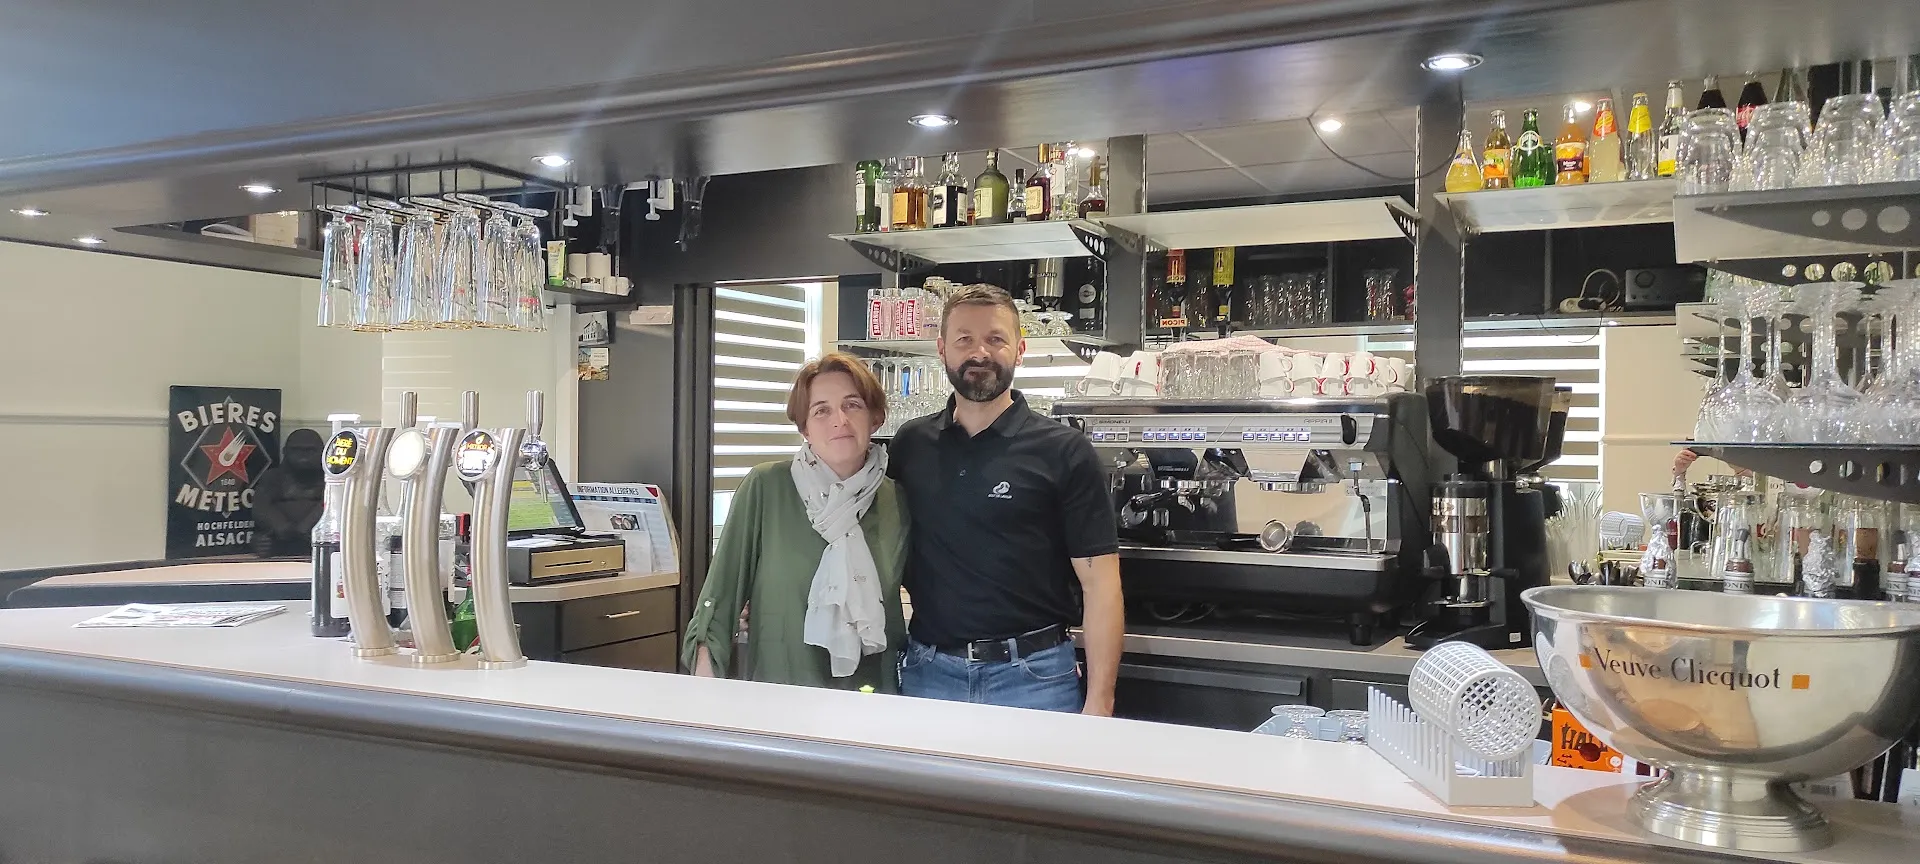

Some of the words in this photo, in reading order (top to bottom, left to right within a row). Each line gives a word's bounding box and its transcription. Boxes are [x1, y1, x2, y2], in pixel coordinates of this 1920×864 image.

[177, 402, 276, 433] BIERES
[576, 485, 609, 494] INFORMATION
[1593, 647, 1662, 679] Veuve
[1670, 656, 1781, 690] Clicquot
